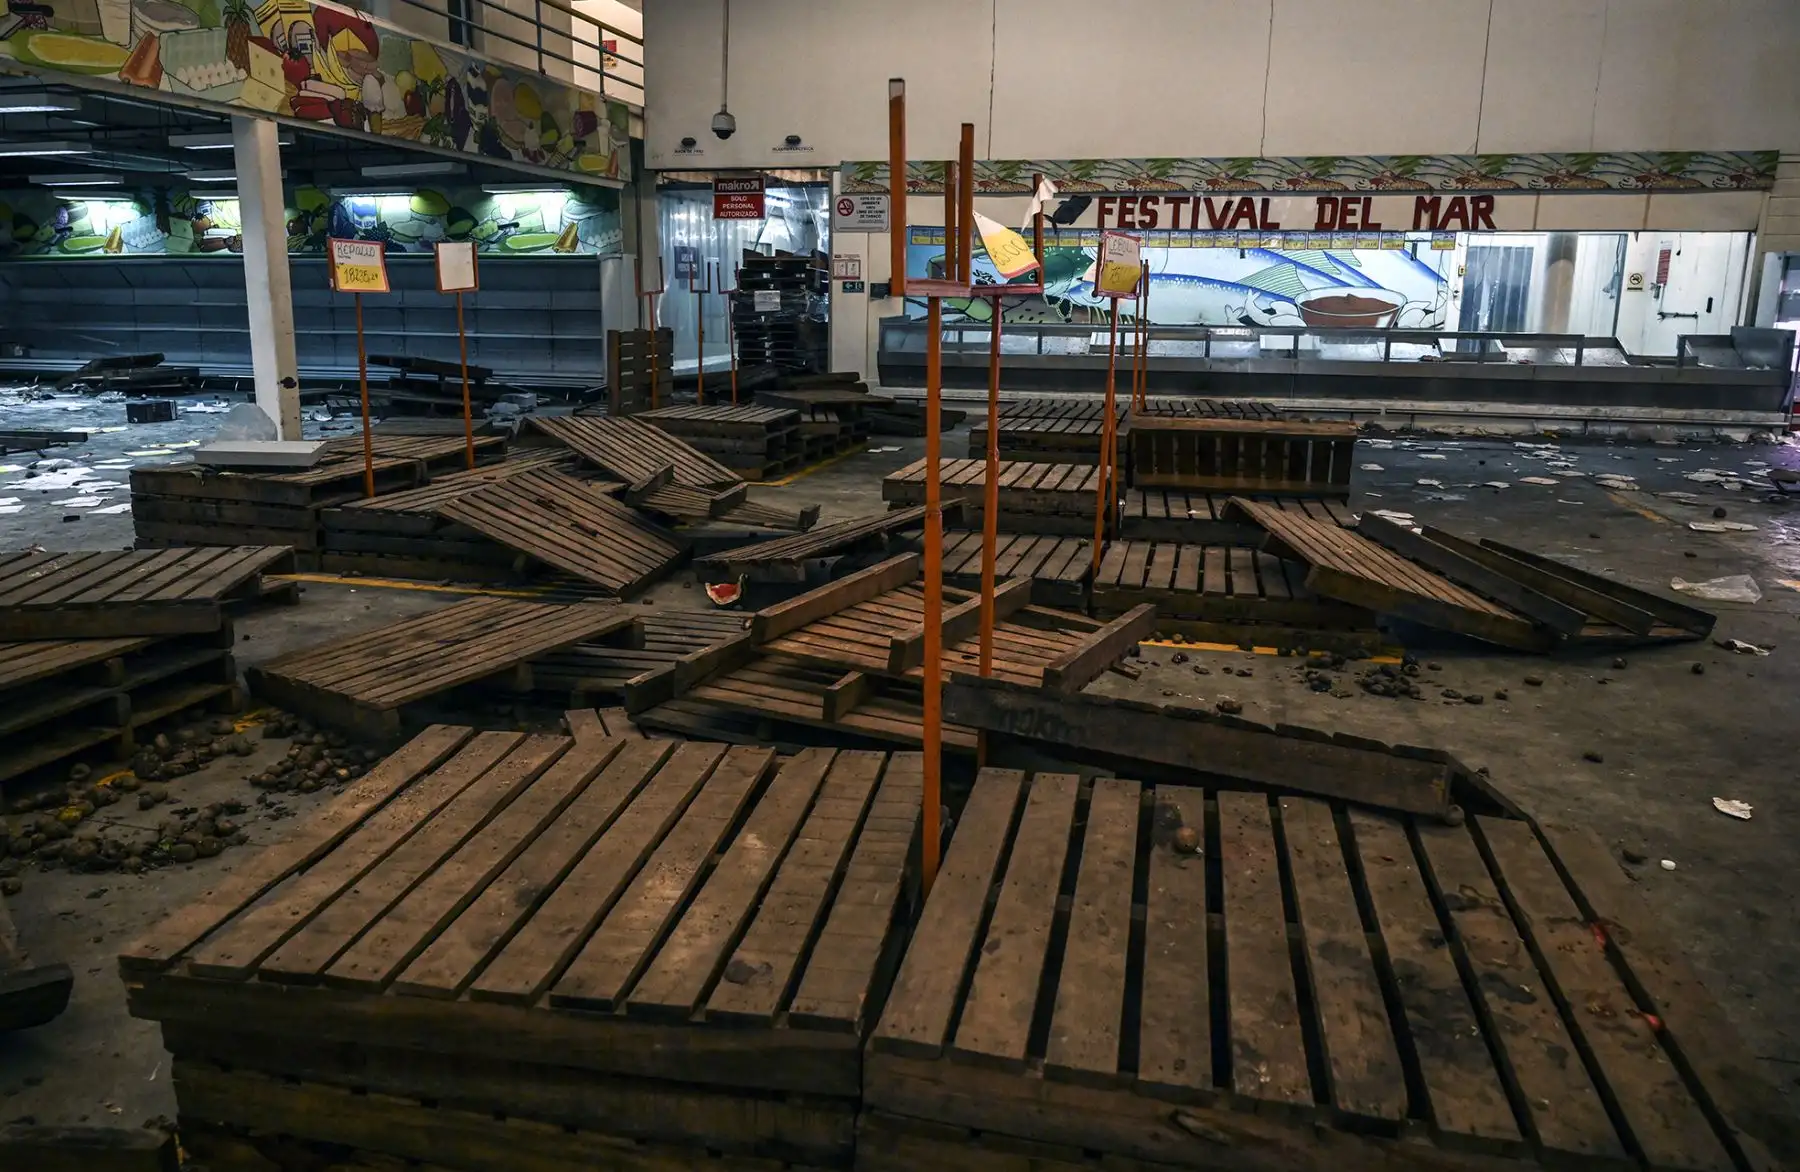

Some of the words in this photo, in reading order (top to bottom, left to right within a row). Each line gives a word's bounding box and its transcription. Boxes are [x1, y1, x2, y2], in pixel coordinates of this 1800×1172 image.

[718, 180, 751, 191] makro
[1098, 196, 1280, 229] FESTIVAL
[1314, 196, 1382, 230] DEL
[1412, 195, 1497, 230] MAR
